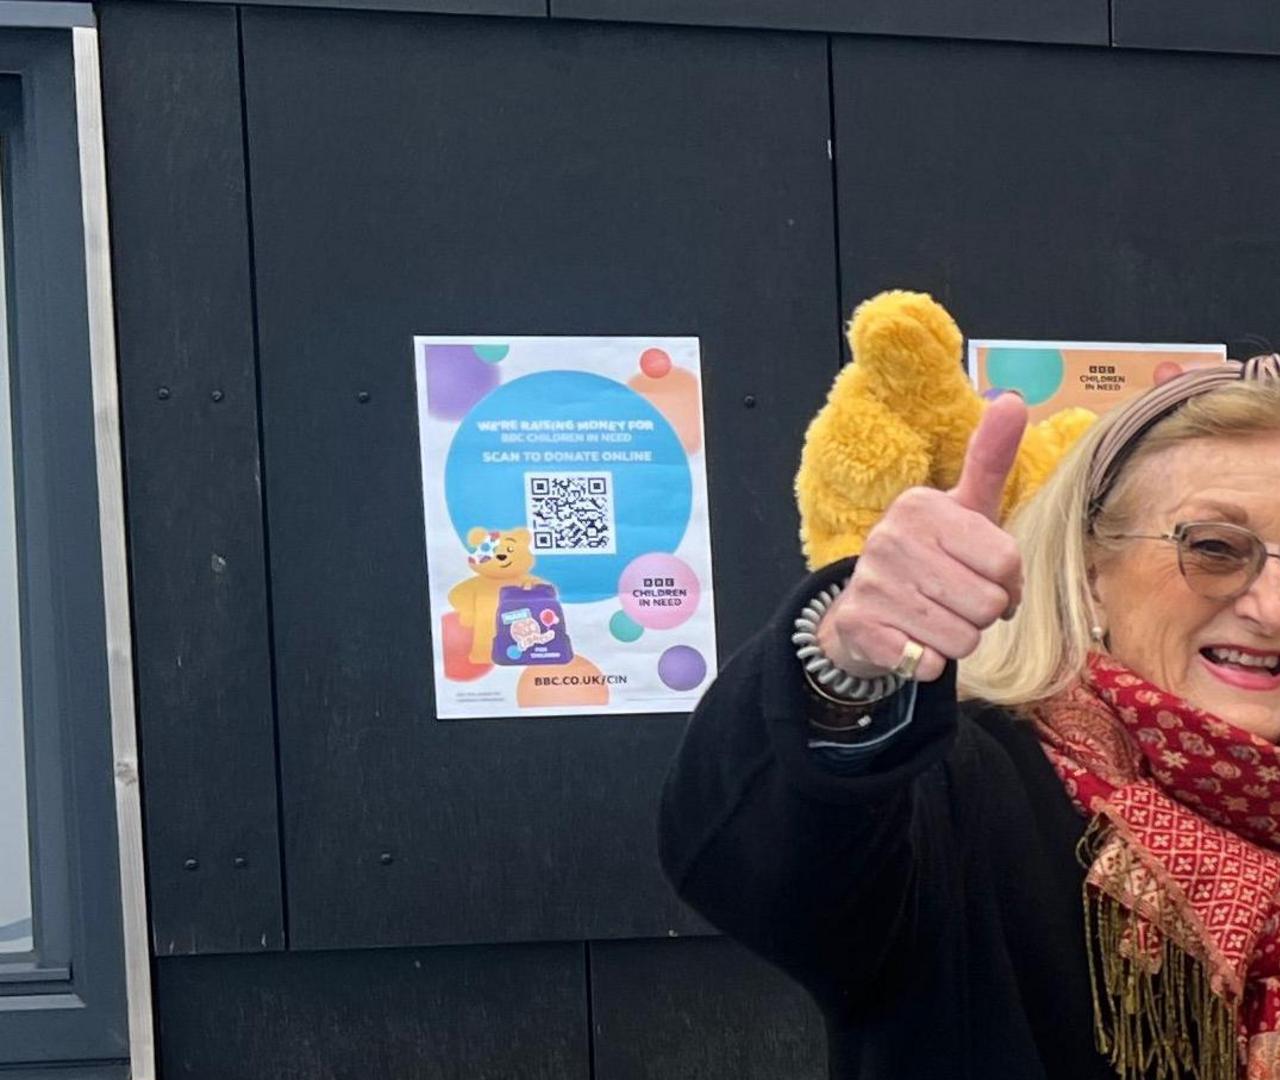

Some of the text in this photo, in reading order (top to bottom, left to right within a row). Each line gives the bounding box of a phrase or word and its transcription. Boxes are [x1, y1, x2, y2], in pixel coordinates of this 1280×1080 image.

[1079, 375, 1126, 383] CHILDREN
[477, 420, 654, 431] WE'RE RAISING MONEY FOR
[526, 433, 584, 443] CHILDREN
[587, 433, 598, 442] IN
[601, 433, 632, 442] NEED
[482, 451, 652, 463] SCAN TO DONATE ONLINE
[632, 589, 687, 597] CHILDREN
[653, 598, 682, 606] NEED
[534, 675, 627, 687] BBC.CO.UK/CIN
